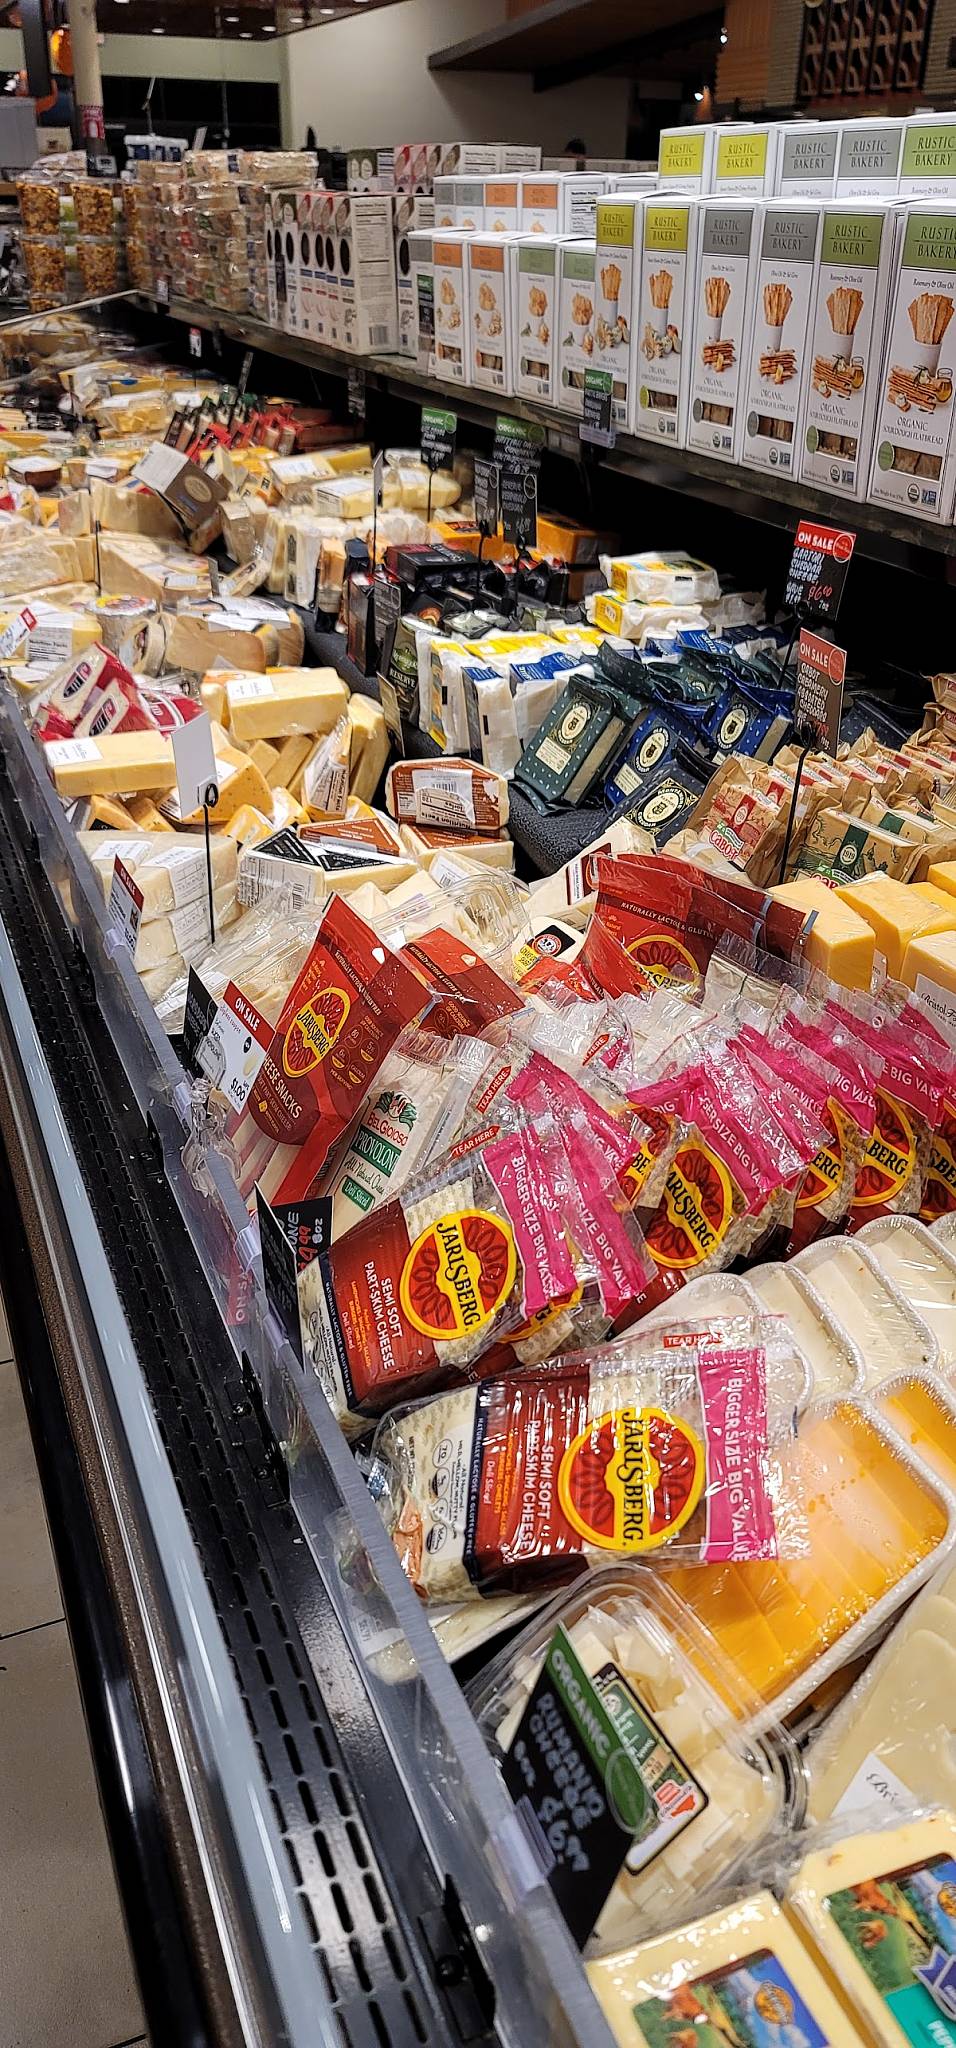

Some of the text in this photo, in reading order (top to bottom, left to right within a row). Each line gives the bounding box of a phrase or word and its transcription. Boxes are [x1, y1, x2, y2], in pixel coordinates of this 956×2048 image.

[670, 143, 694, 154] RUSTIC
[728, 142, 755, 154] RUSTIC
[795, 142, 827, 155] RUSTIC
[853, 140, 887, 152] RUSTIC
[917, 136, 956, 149] RUSTIC
[668, 158, 692, 168] BAKERY
[726, 158, 753, 168] BAKERY
[793, 158, 825, 169] BAKERY
[851, 156, 884, 168] BAKERY
[915, 152, 952, 166] BAKERY
[654, 216, 678, 227] RUSTIC
[714, 219, 740, 231] RUSTIC
[775, 222, 803, 235] RUSTIC
[835, 225, 868, 238] RUSTIC
[653, 231, 677, 242] BAKERY
[712, 234, 738, 246] BAKERY
[772, 237, 802, 251] BAKERY
[921, 227, 956, 241] RUSTI
[832, 241, 865, 255] BAKERY
[820, 402, 846, 417] ORGANIC
[897, 416, 928, 432] ORGANIC
[883, 426, 944, 446] SOURDOUGH FLATBREAD
[798, 531, 834, 551] ON SALE
[800, 643, 829, 668] ON SALE
[390, 668, 416, 688] RESERVE
[621, 901, 658, 920] NATURALLY
[334, 949, 351, 973] NATURALLY
[235, 996, 261, 1032] ON SALE
[297, 1008, 331, 1057] JARLSBERG
[588, 1037, 606, 1055] HERE
[263, 1054, 281, 1085] HEESE
[275, 1079, 303, 1119] SNACKS
[835, 1074, 851, 1092] BIG
[891, 1067, 912, 1086] BIG
[230, 1077, 246, 1102] $1.00
[479, 1071, 510, 1114] TEAR HERE
[453, 1128, 496, 1156] TEAR HERE
[712, 1119, 751, 1166] SIZE BIG
[344, 1180, 371, 1207] Deli Sliced
[511, 1155, 546, 1259] BIGGER SIZE BIG
[597, 1234, 613, 1260] BIG
[436, 1222, 481, 1327] JARLSBERG
[364, 1261, 395, 1371] PART-SKIM CHEESE
[381, 1277, 403, 1338] SEMI SOFT
[325, 1281, 336, 1316] NATURALLY
[331, 1316, 343, 1347] LACTOSE
[340, 1352, 349, 1380] GLUTEN
[345, 1380, 353, 1398] FREE
[341, 1311, 355, 1350] Deli Sliced
[668, 1335, 692, 1346] TEAR
[725, 1377, 744, 1428] BIGGER
[473, 1417, 484, 1460] NATURALLY
[725, 1430, 742, 1467] SIZE
[470, 1460, 480, 1493] LACTOSE
[483, 1460, 496, 1504] Deli Sliced
[537, 1444, 554, 1520] SEMI SOFT
[616, 1411, 646, 1543] JARLSBERG
[728, 1469, 743, 1505] BIG
[468, 1502, 477, 1530] GLUTEN
[519, 1492, 537, 1551] CHEESE
[551, 1648, 611, 1759] ORGANIC
